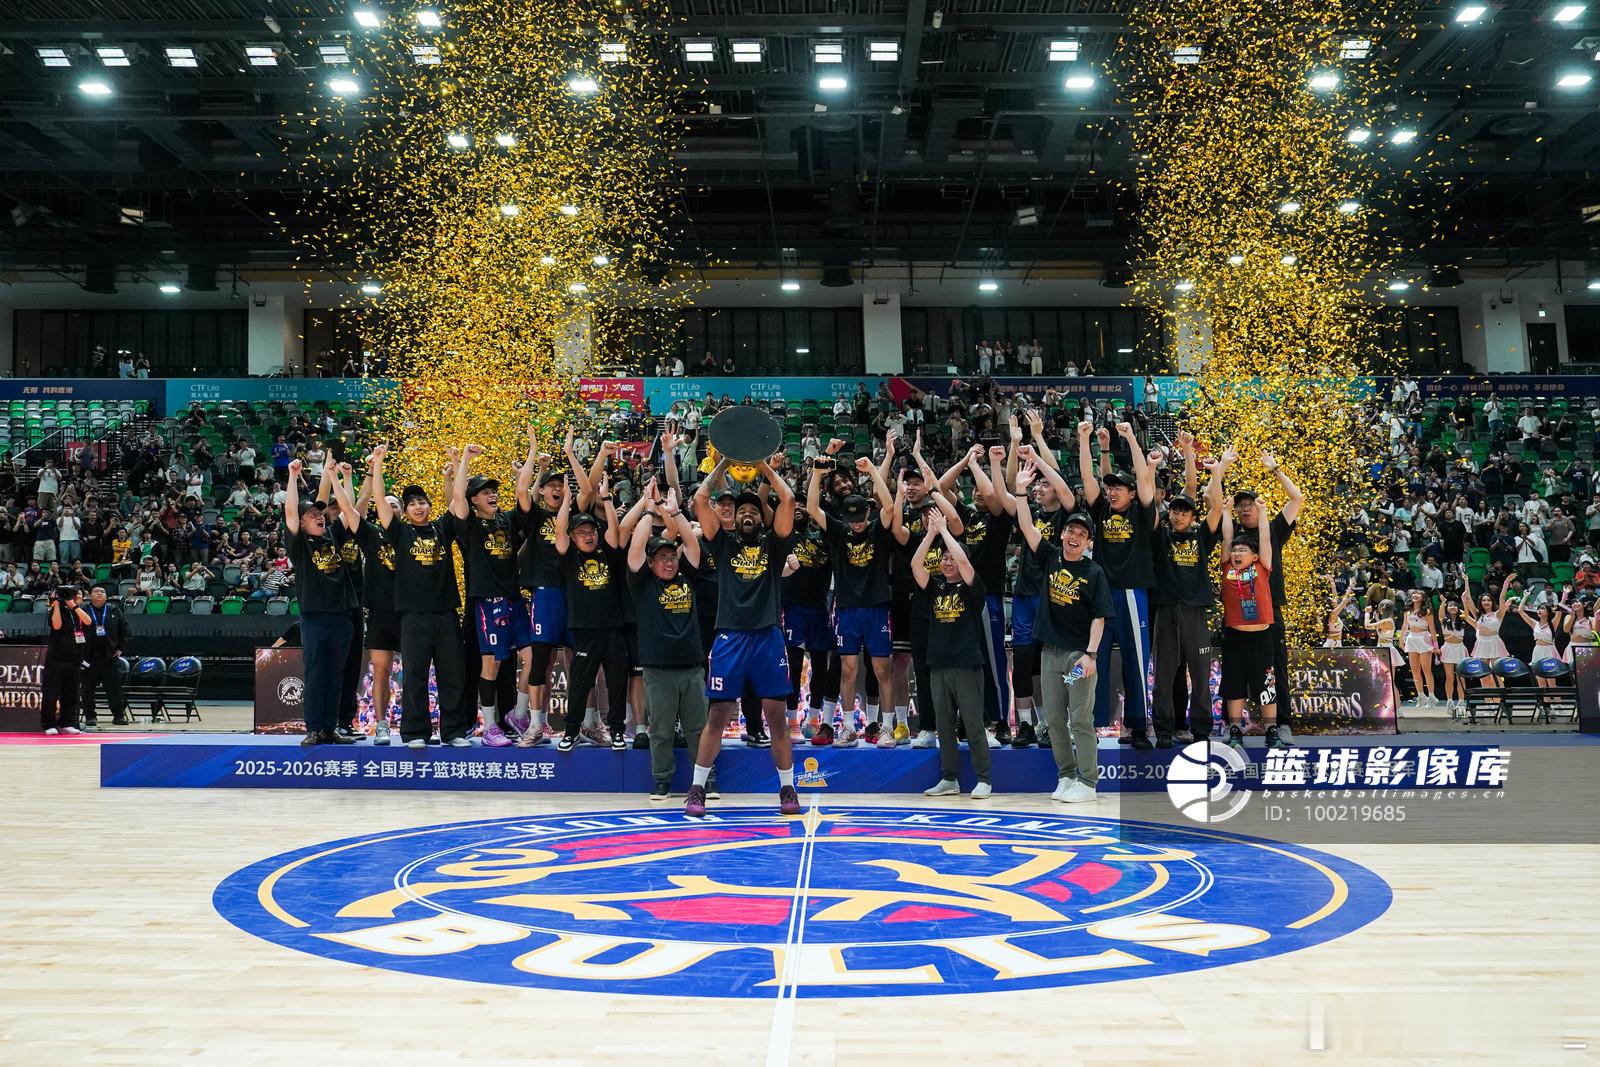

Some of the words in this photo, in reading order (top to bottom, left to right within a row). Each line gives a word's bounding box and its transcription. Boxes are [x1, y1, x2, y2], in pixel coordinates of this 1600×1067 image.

[670, 383, 685, 391] CTF
[687, 383, 701, 391] Life
[750, 383, 766, 391] CTF
[768, 383, 782, 391] Life
[831, 383, 847, 391] CTF
[535, 623, 542, 635] 9
[786, 629, 793, 641] 7
[489, 633, 498, 646] 0
[836, 635, 844, 647] 31
[711, 676, 723, 691] 15
[235, 760, 358, 777] 2025-2026赛季
[363, 760, 556, 780] 全国男子篮球联赛总冠军
[900, 813, 1114, 836] KONG
[307, 913, 1271, 987] BULLS
